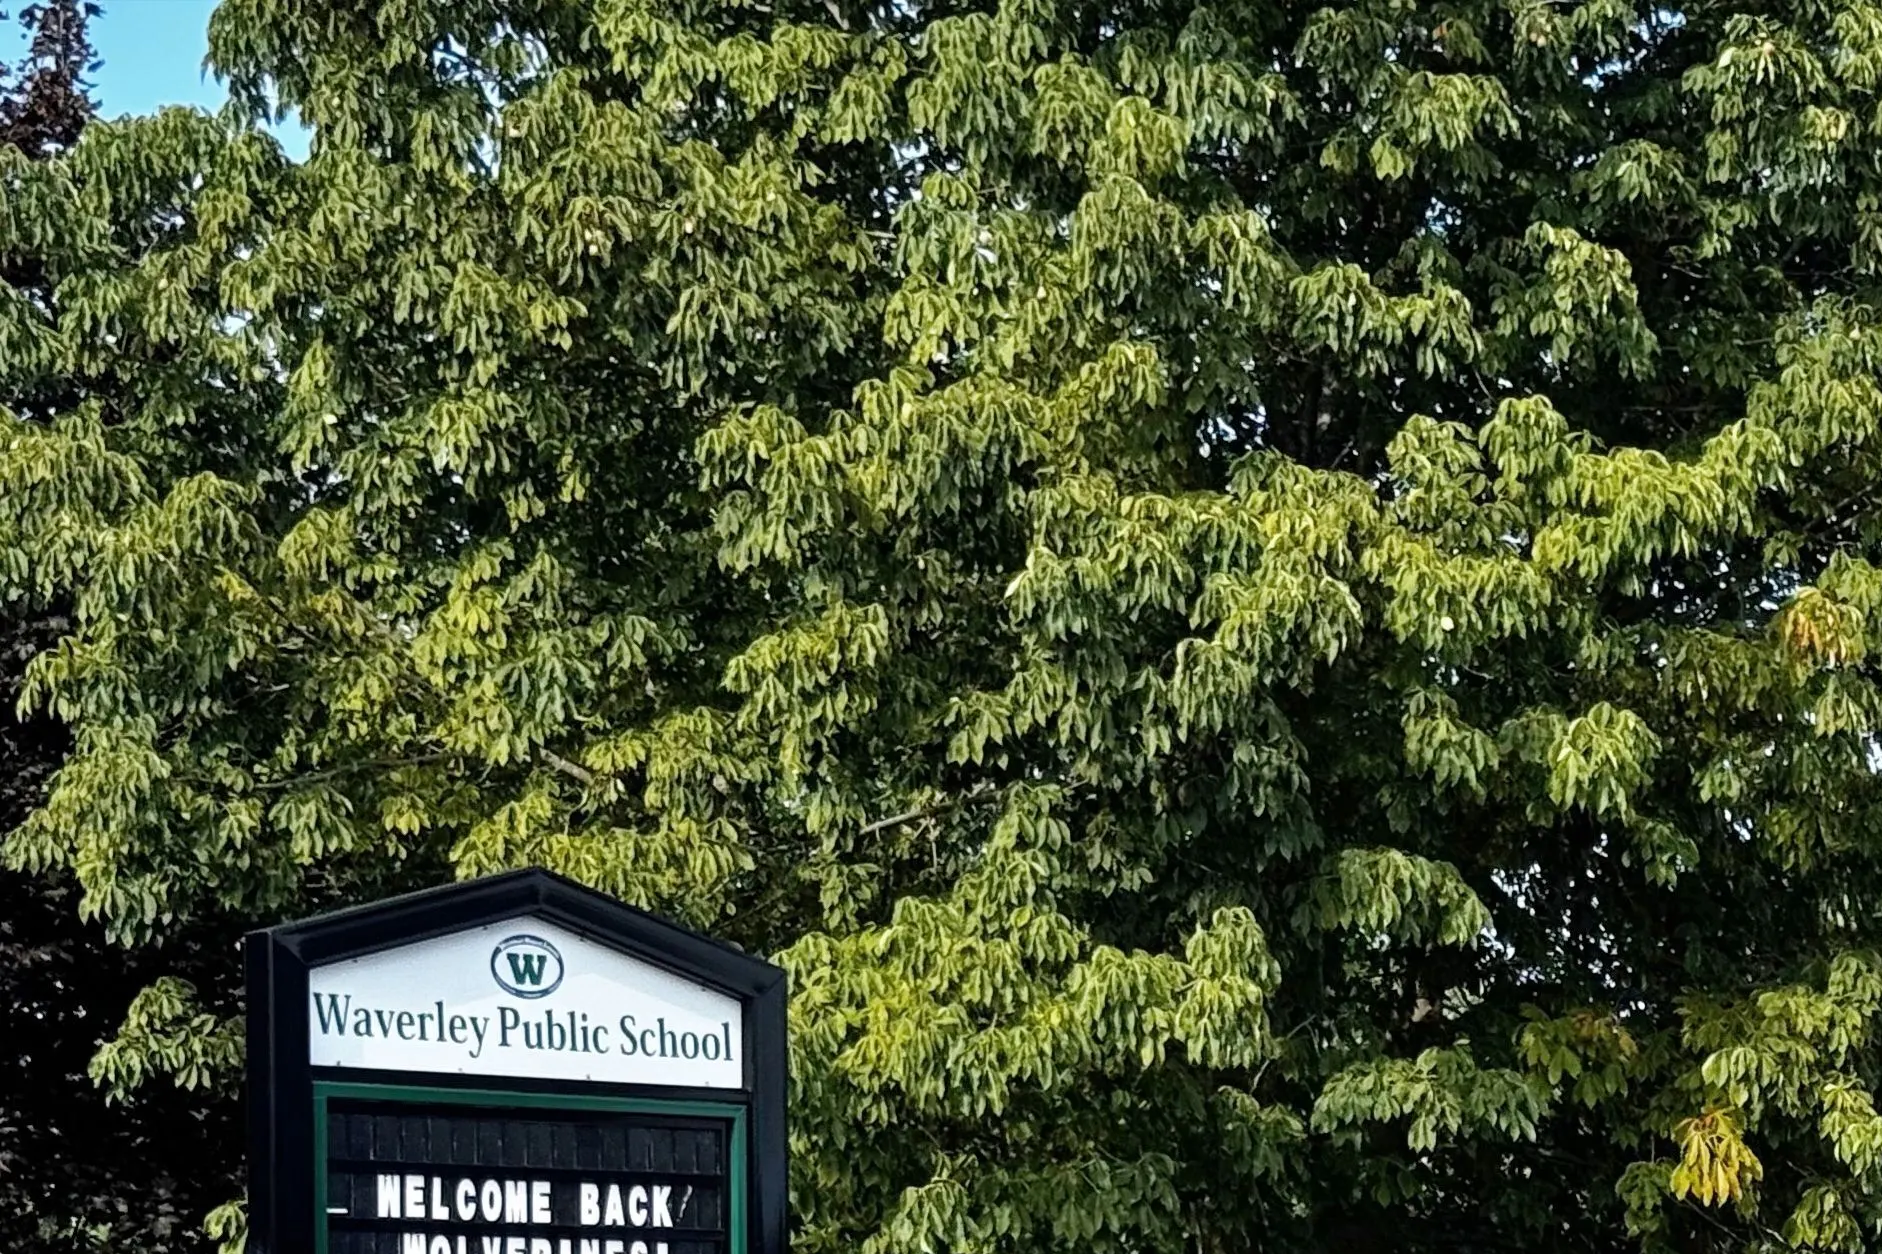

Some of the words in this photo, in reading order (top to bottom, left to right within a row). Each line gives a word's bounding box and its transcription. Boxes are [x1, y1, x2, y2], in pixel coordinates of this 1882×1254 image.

[506, 953, 547, 985] W
[313, 992, 490, 1058] Waverley
[497, 1006, 610, 1054] Public
[619, 1014, 734, 1061] School
[377, 1174, 551, 1223] WELCOME
[580, 1183, 674, 1228] BACK
